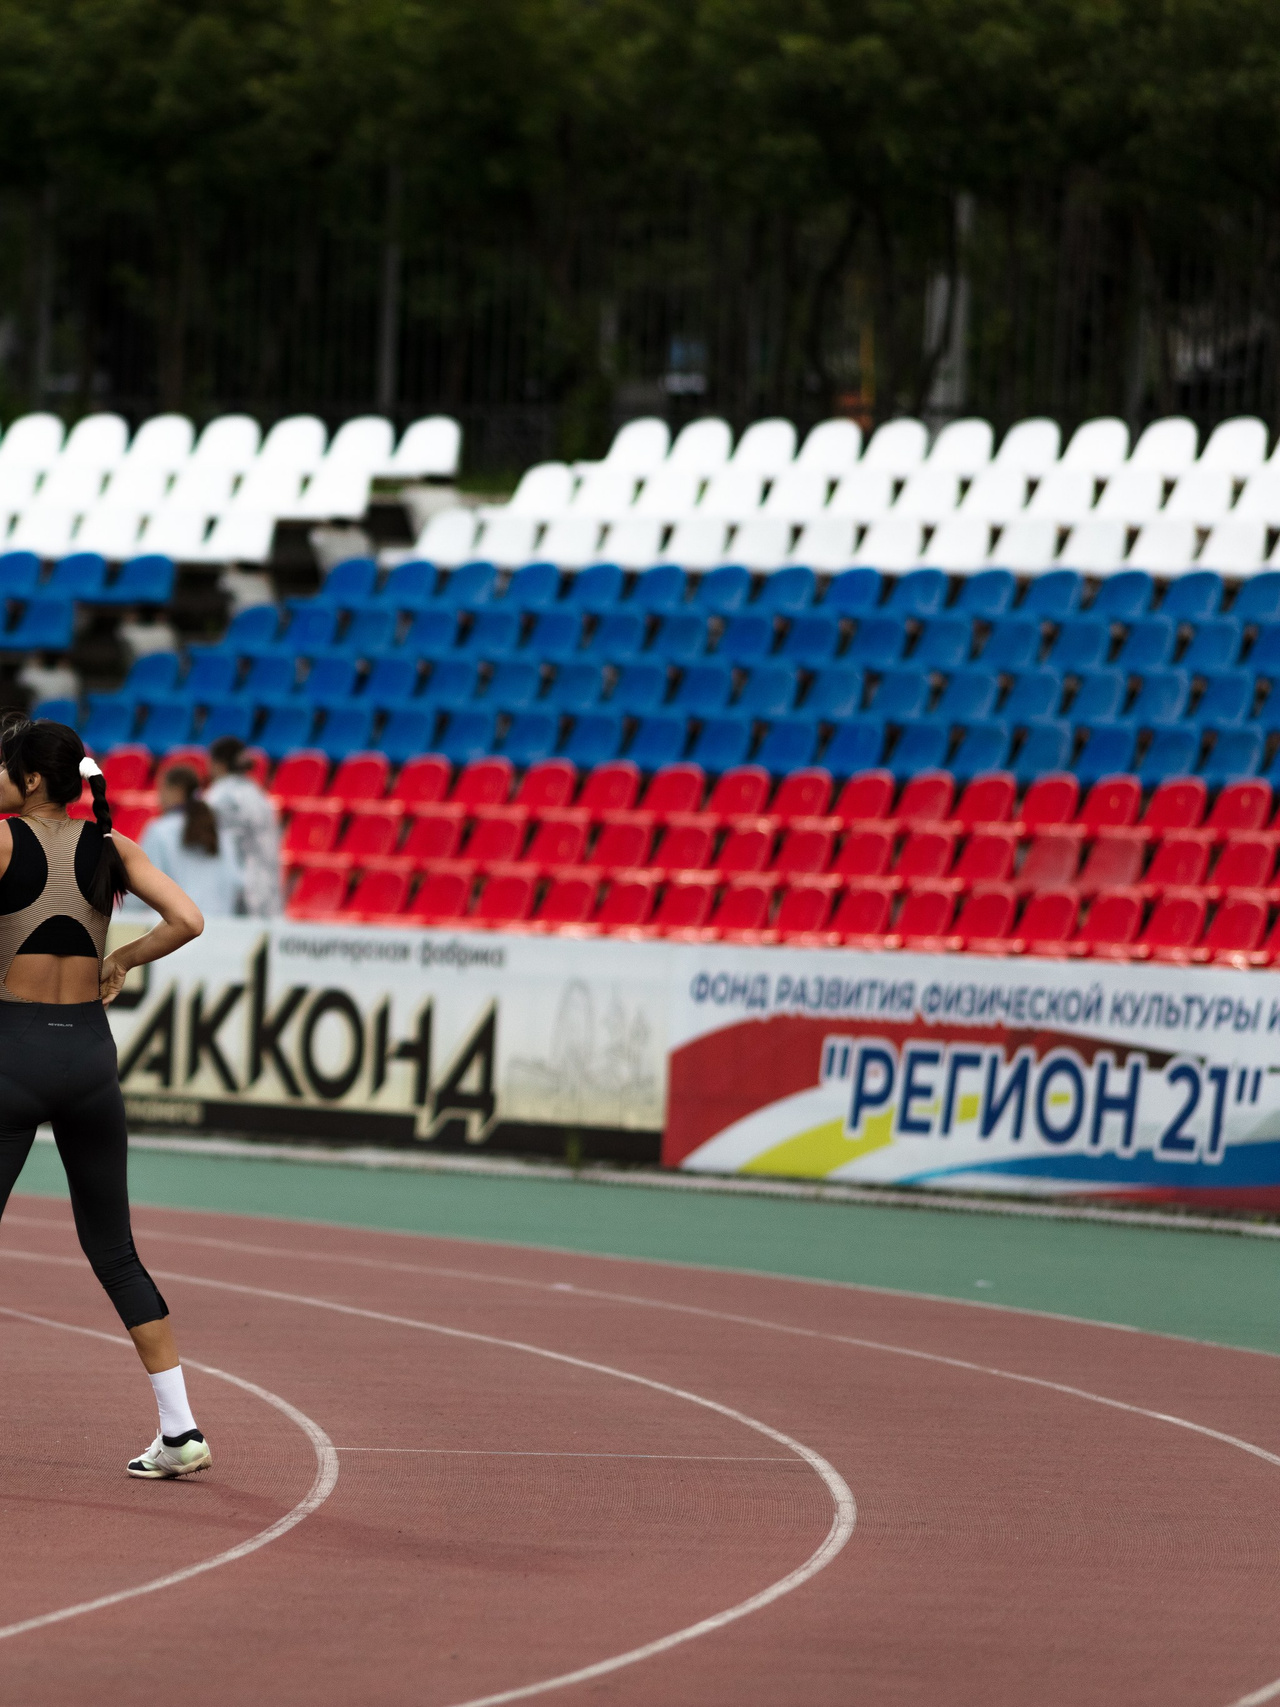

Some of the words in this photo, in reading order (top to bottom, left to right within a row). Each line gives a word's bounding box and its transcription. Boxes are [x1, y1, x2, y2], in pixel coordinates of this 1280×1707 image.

[419, 940, 507, 972] фабрика
[691, 971, 769, 1008] ФОНД
[775, 976, 915, 1014] РАЗВИТИЯ
[920, 979, 1101, 1024] ФИЗИЧЕСКОЙ
[1109, 993, 1262, 1032] КУЛЬТУРЫ
[825, 1043, 1141, 1148] "РЕГИОН
[1160, 1064, 1262, 1155] 21"
